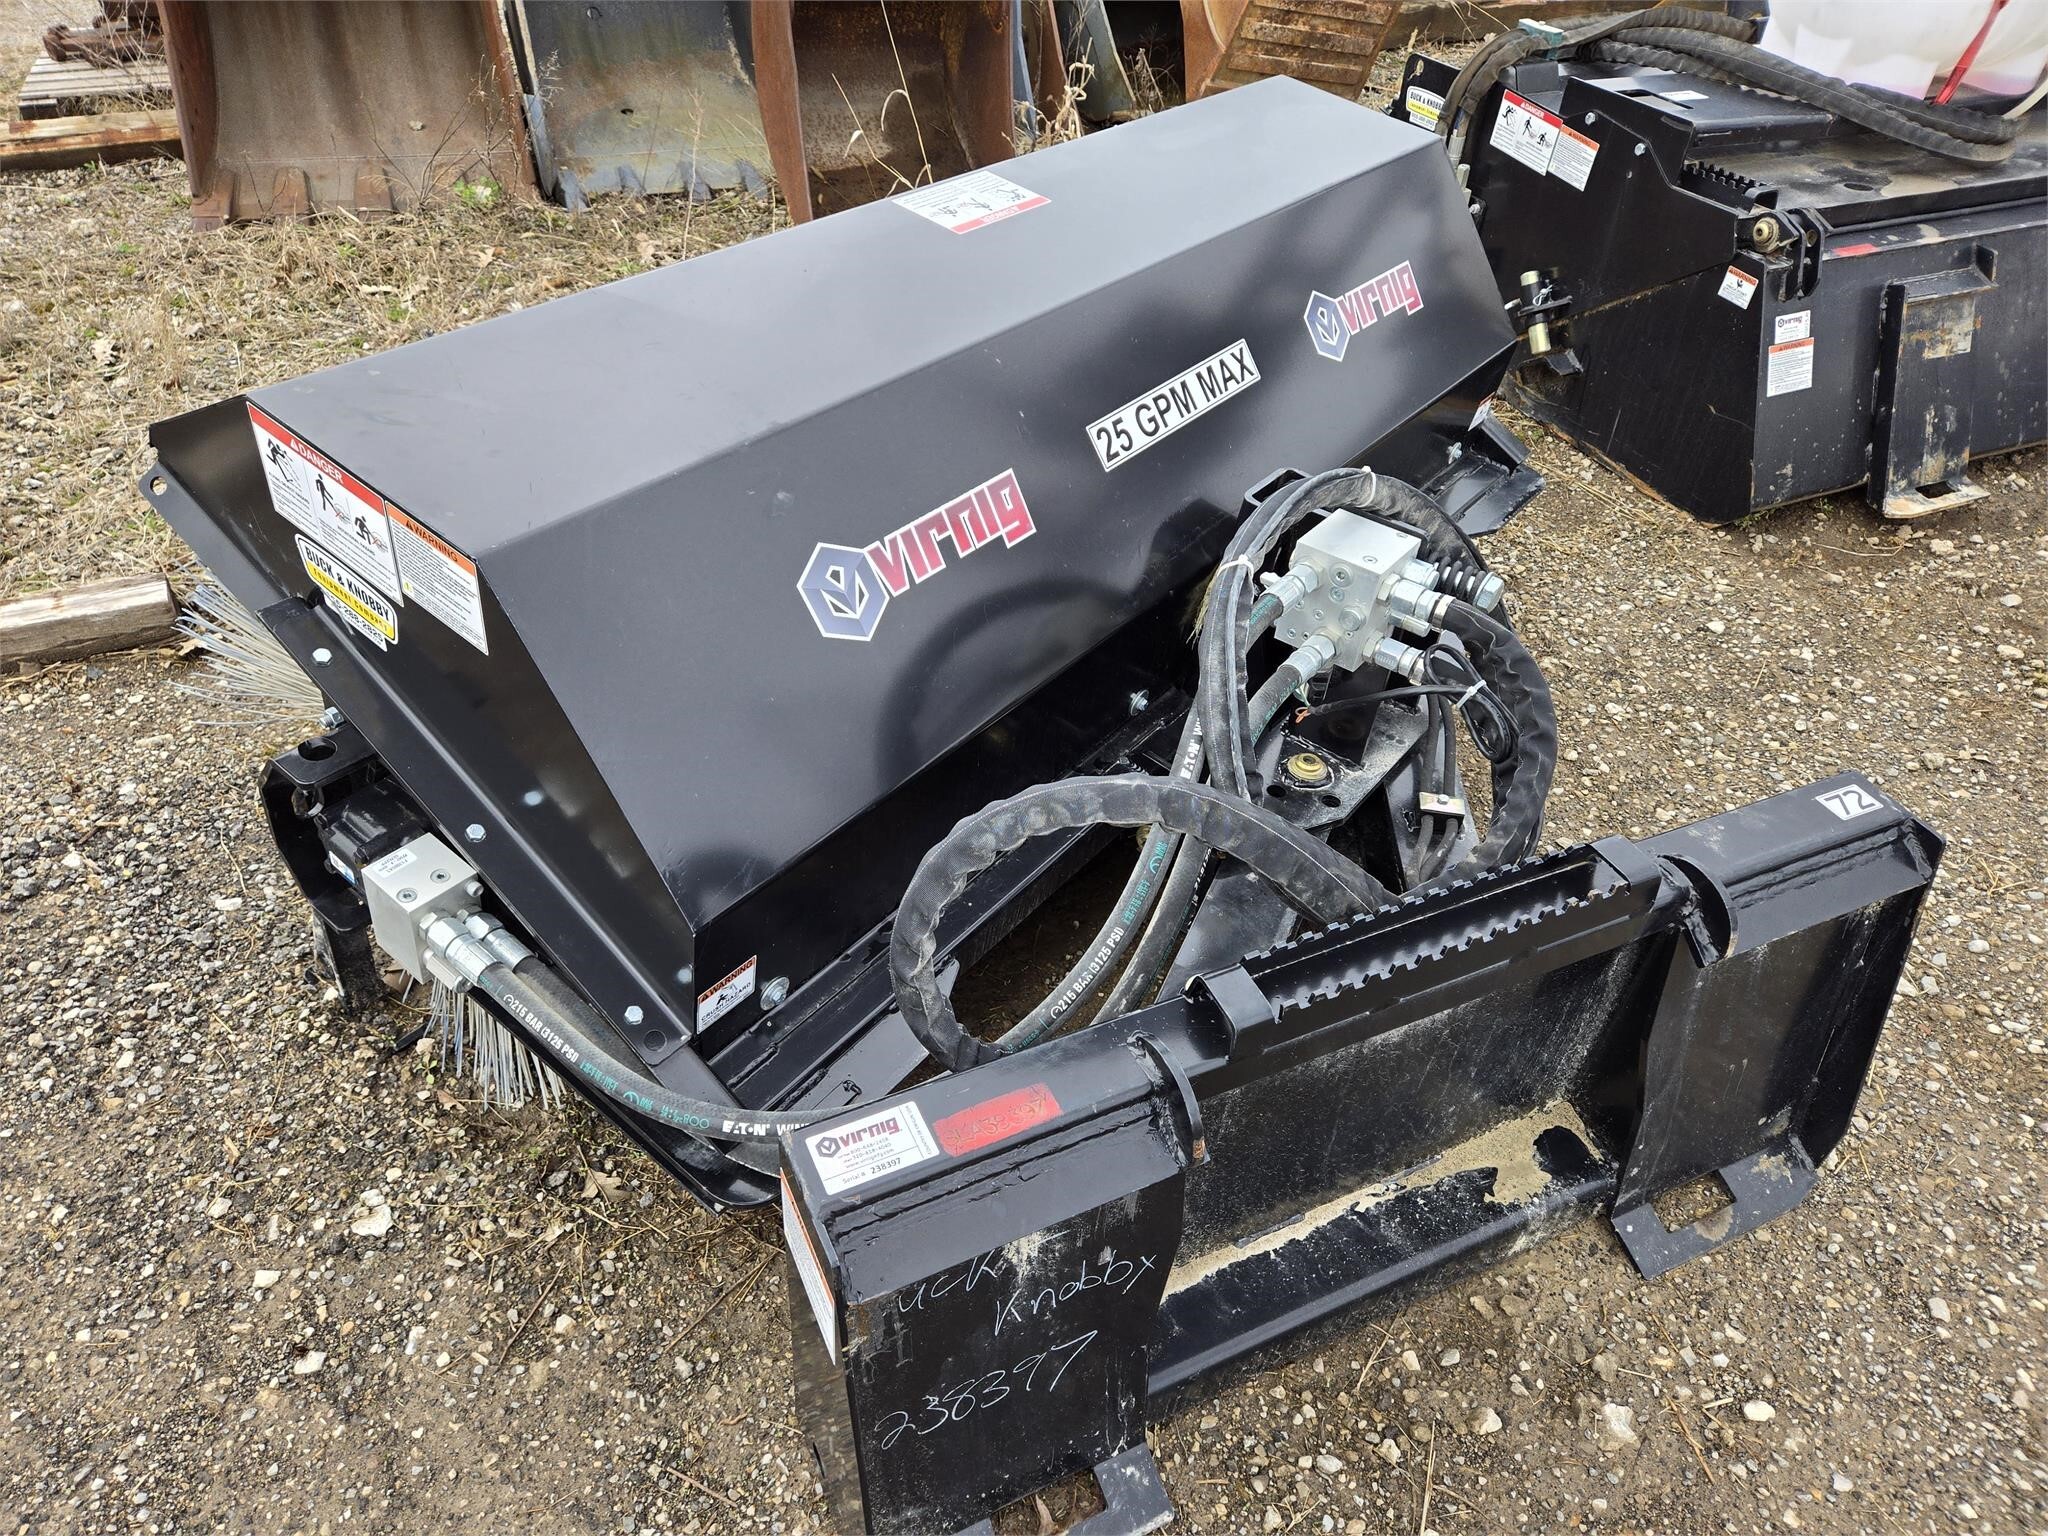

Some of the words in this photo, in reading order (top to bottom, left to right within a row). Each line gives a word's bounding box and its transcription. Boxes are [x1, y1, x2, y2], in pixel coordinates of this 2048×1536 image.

[1524, 102, 1544, 119] DANGER
[1336, 260, 1424, 335] virnig
[1096, 417, 1134, 463] 25
[1134, 380, 1199, 438] GPM
[1195, 347, 1255, 403] MAX
[298, 442, 344, 485] DANGER
[411, 523, 458, 563] WARNING
[864, 468, 1037, 597] virnig
[304, 546, 335, 578] BUCK
[336, 572, 345, 586] &
[346, 578, 390, 621] KNOBBY
[1823, 790, 1876, 816] 72
[709, 960, 753, 994] WARNING
[1059, 989, 1077, 1012] 215
[1073, 971, 1095, 996] BAR
[511, 999, 527, 1018] 215
[524, 1007, 543, 1034] BAR
[701, 1002, 724, 1021] CRUSH
[725, 982, 752, 1005] HAZARD
[839, 1117, 901, 1147] virnig
[842, 1174, 860, 1184] Serial
[870, 1157, 902, 1175] 238397
[874, 1330, 1097, 1449] 238397
